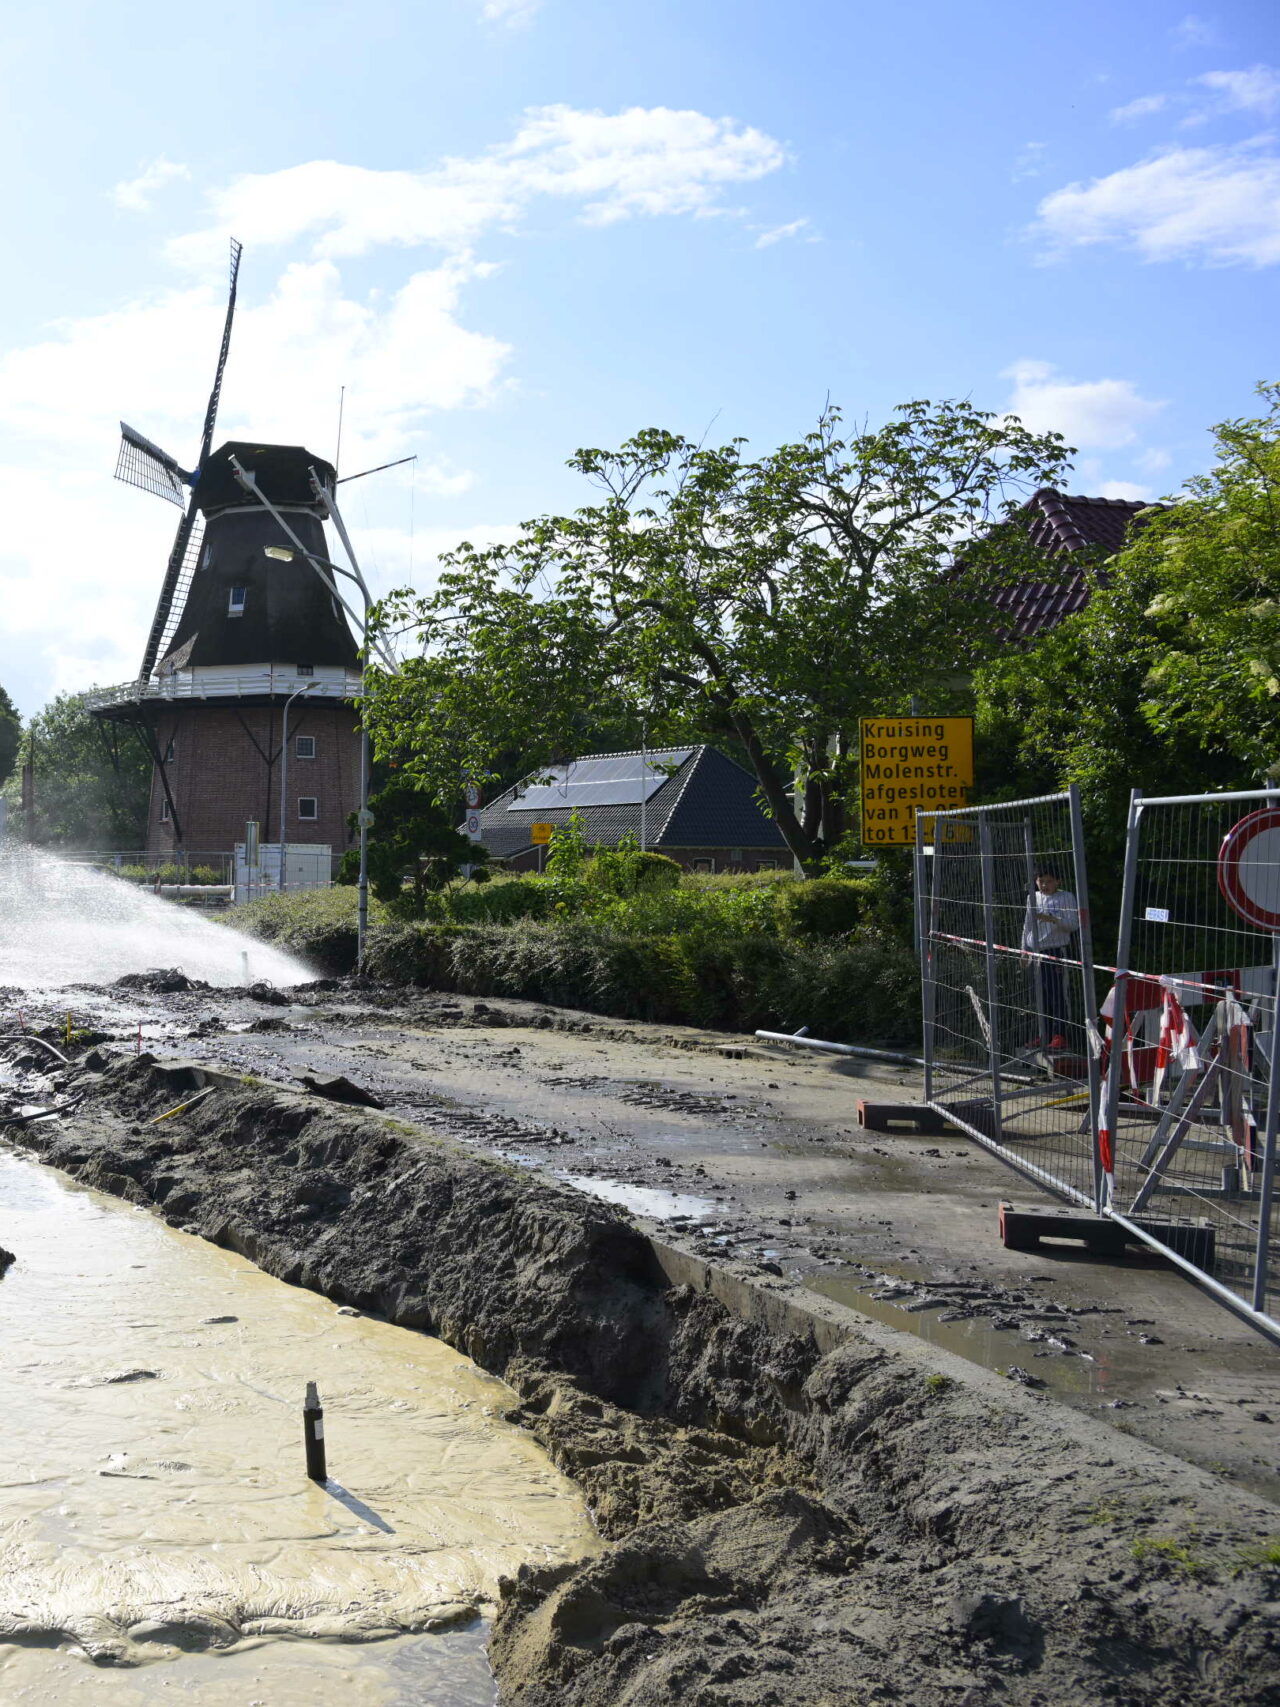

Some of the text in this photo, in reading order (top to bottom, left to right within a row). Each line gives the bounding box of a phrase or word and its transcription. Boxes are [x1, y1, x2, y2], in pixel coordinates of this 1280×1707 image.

[865, 722, 945, 740] Kruising
[865, 744, 948, 761] Borgweg
[866, 764, 958, 779] Molenstr.
[866, 807, 899, 820] van
[866, 825, 895, 841] tot
